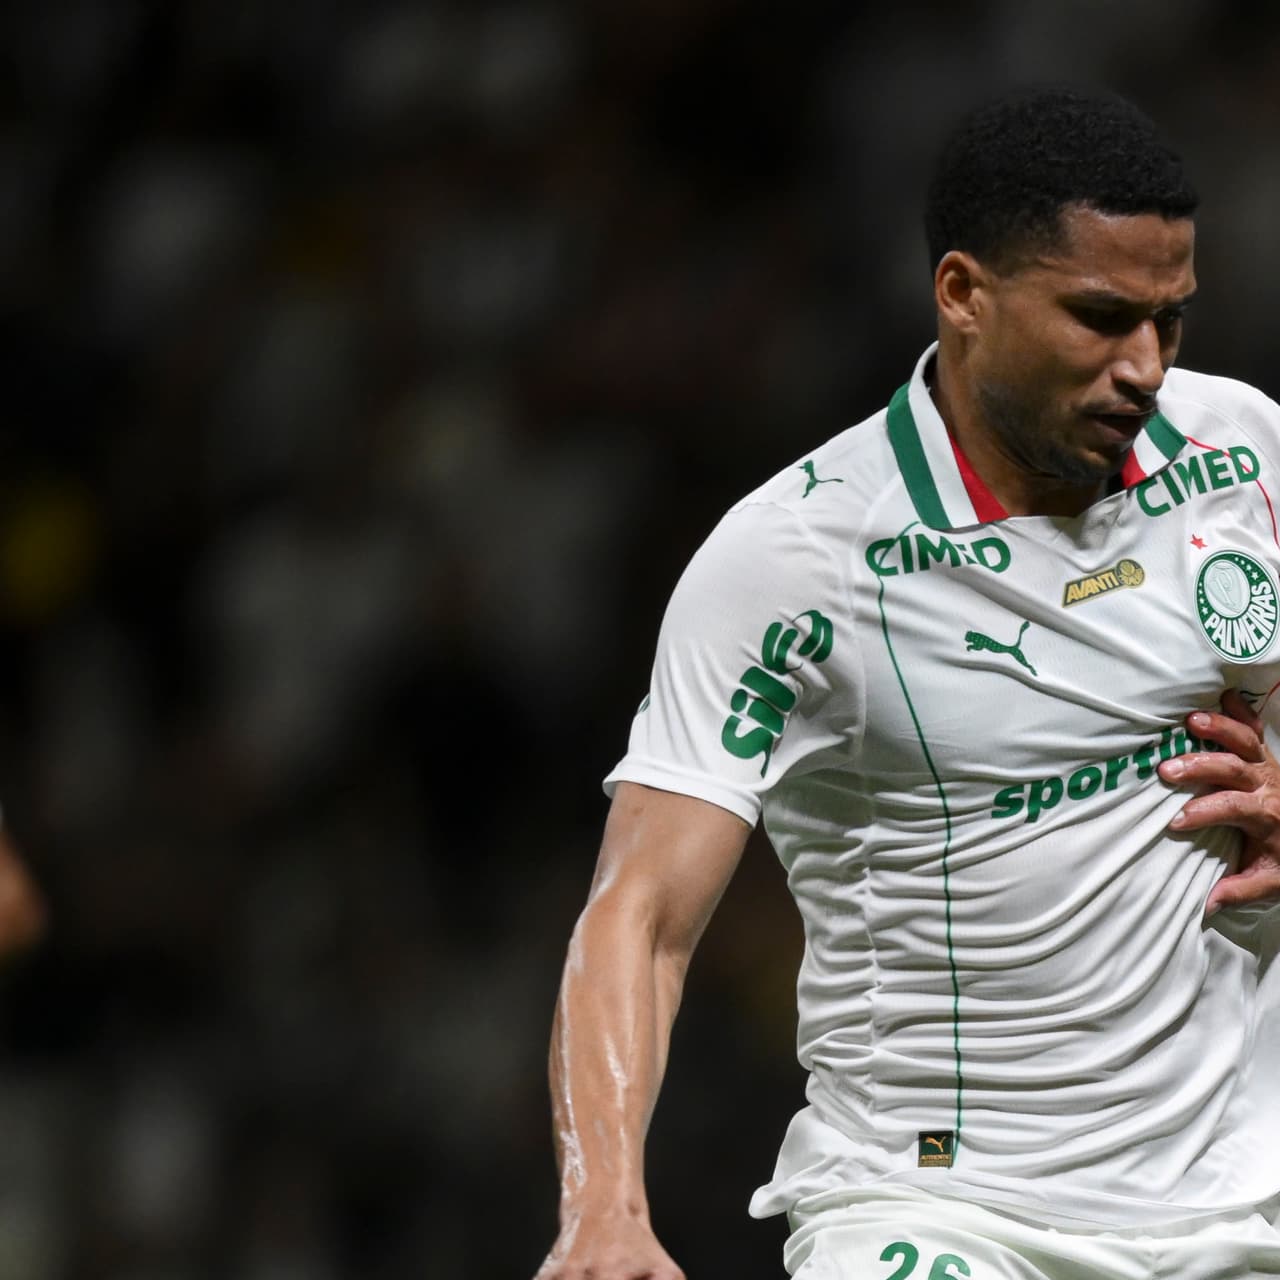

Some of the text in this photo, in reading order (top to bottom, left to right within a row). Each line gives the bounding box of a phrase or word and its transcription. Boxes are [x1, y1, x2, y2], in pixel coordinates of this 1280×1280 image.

[1136, 446, 1260, 517] CIMED
[1066, 571, 1120, 604] AVANTI
[1204, 581, 1276, 657] PALMEIRAS
